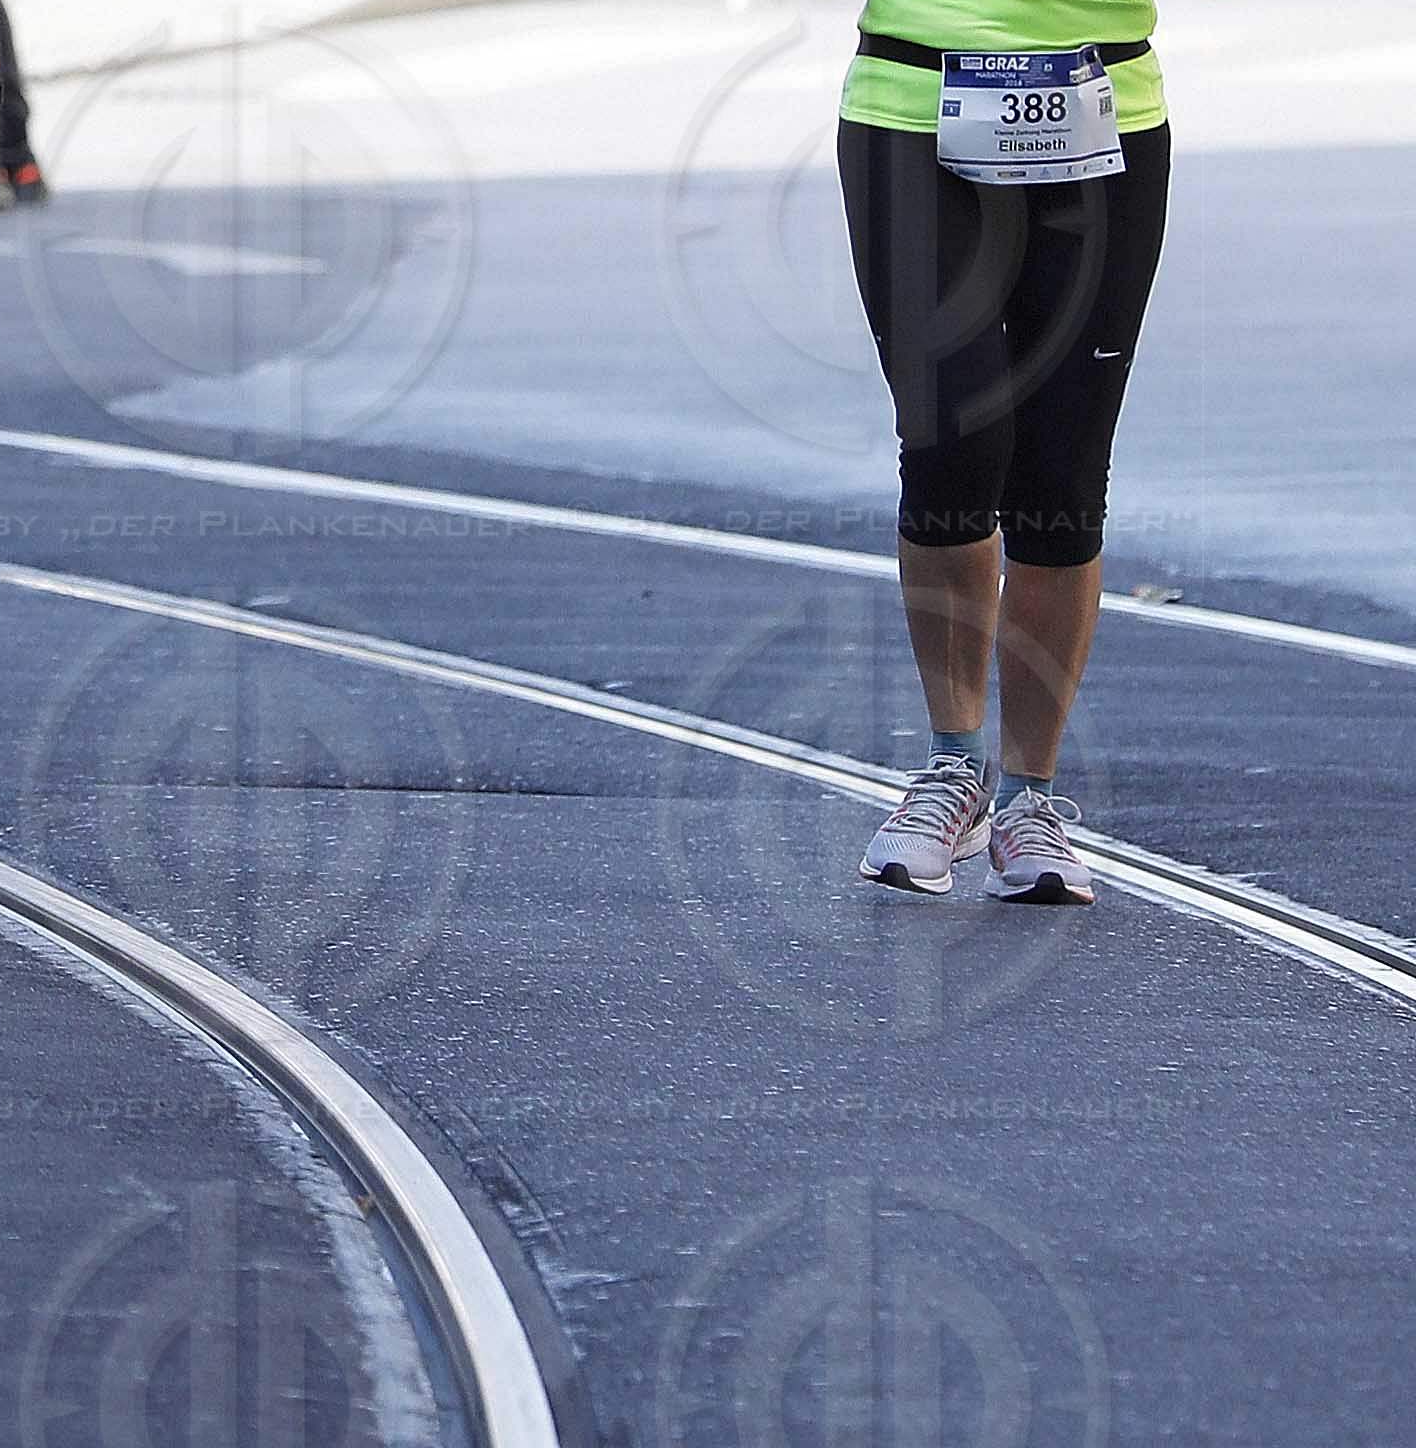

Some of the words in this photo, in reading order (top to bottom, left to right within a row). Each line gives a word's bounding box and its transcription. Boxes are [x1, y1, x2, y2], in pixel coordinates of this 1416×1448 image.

[985, 57, 1030, 71] GRAZ
[975, 71, 1017, 80] MARATHON
[1000, 92, 1068, 125] 388
[998, 138, 1067, 153] Elisabeth
